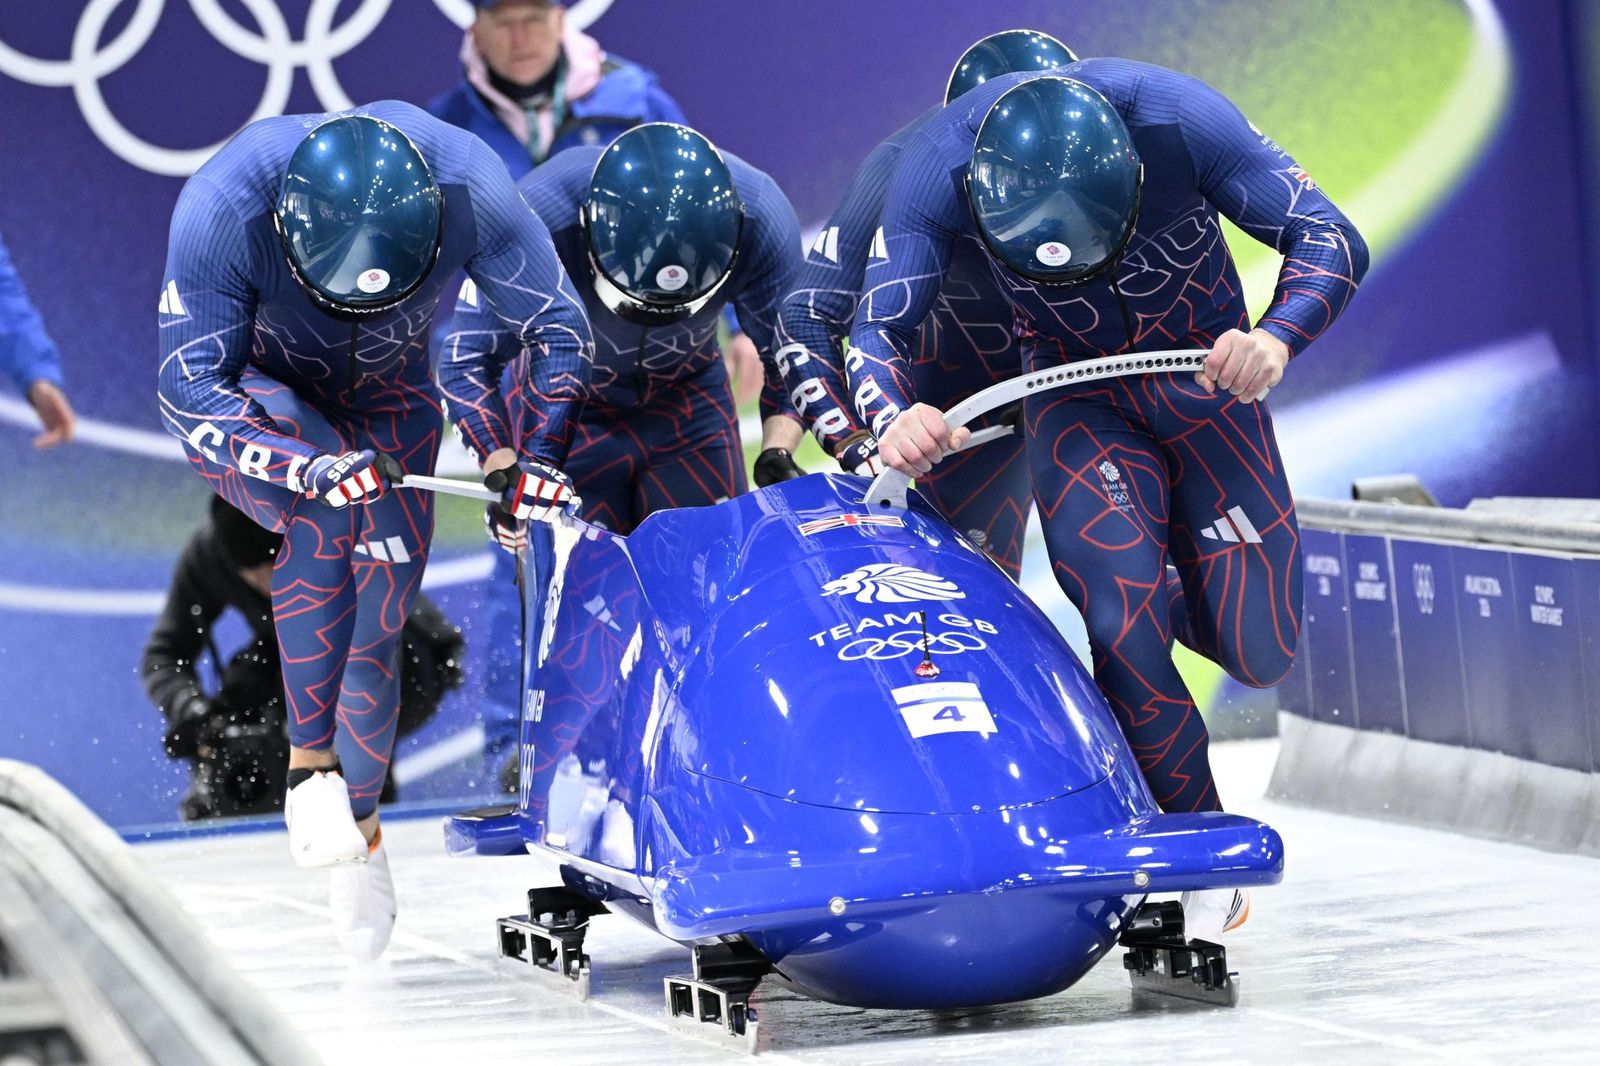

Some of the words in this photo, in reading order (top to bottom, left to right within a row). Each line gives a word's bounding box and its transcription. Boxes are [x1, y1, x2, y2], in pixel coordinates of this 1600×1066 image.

[857, 437, 878, 460] SE
[326, 451, 365, 483] SEIZ
[528, 461, 568, 483] IZ
[809, 611, 925, 647] TEAM
[938, 613, 999, 635] GB
[932, 705, 967, 722] 4
